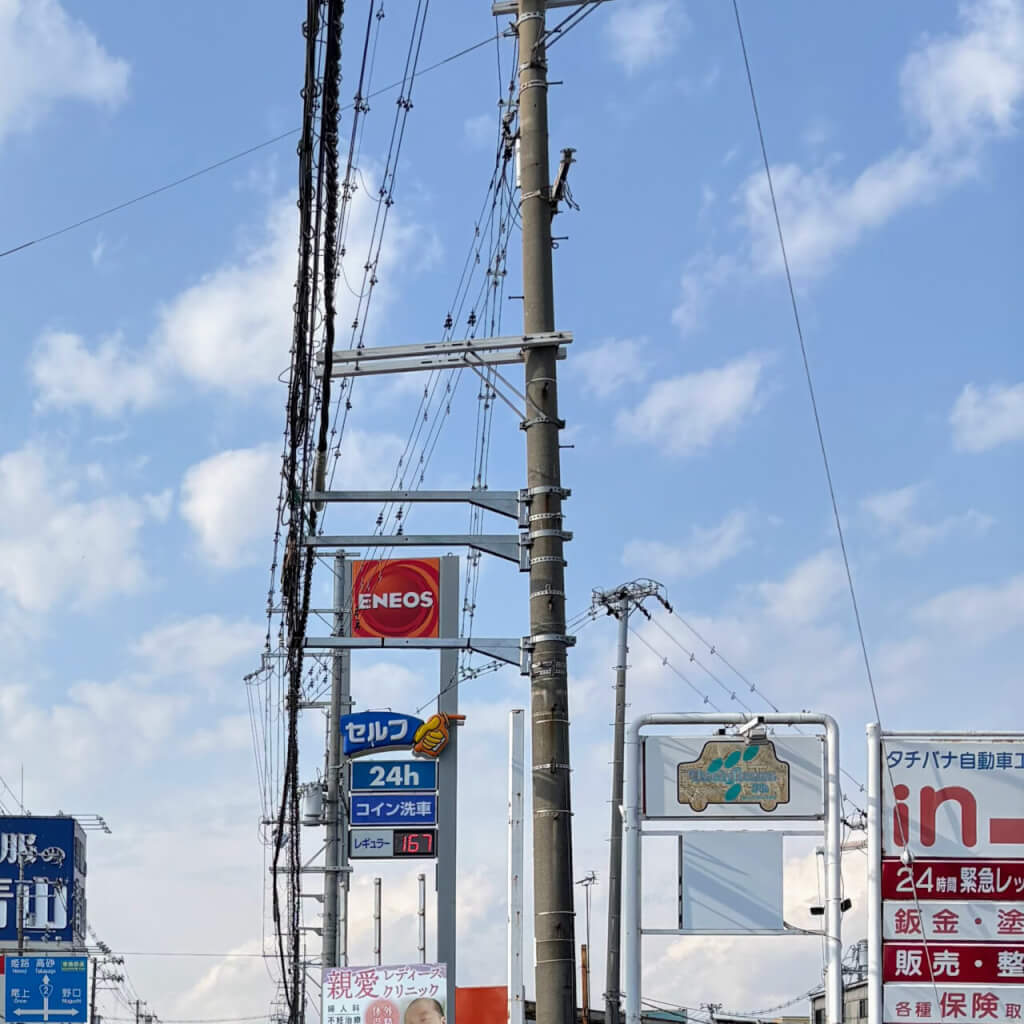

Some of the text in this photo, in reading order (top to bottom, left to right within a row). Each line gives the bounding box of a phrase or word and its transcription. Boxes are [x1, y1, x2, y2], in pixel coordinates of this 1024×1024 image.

[358, 591, 433, 609] ENEOS
[345, 719, 408, 743] セルフ
[369, 764, 419, 786] 24h
[356, 801, 432, 817] コイン洗車
[354, 834, 433, 853] レギュラー 167
[43, 986, 49, 995] 2
[327, 967, 443, 1000] 親愛 レディース
[383, 984, 439, 998] クリニック
